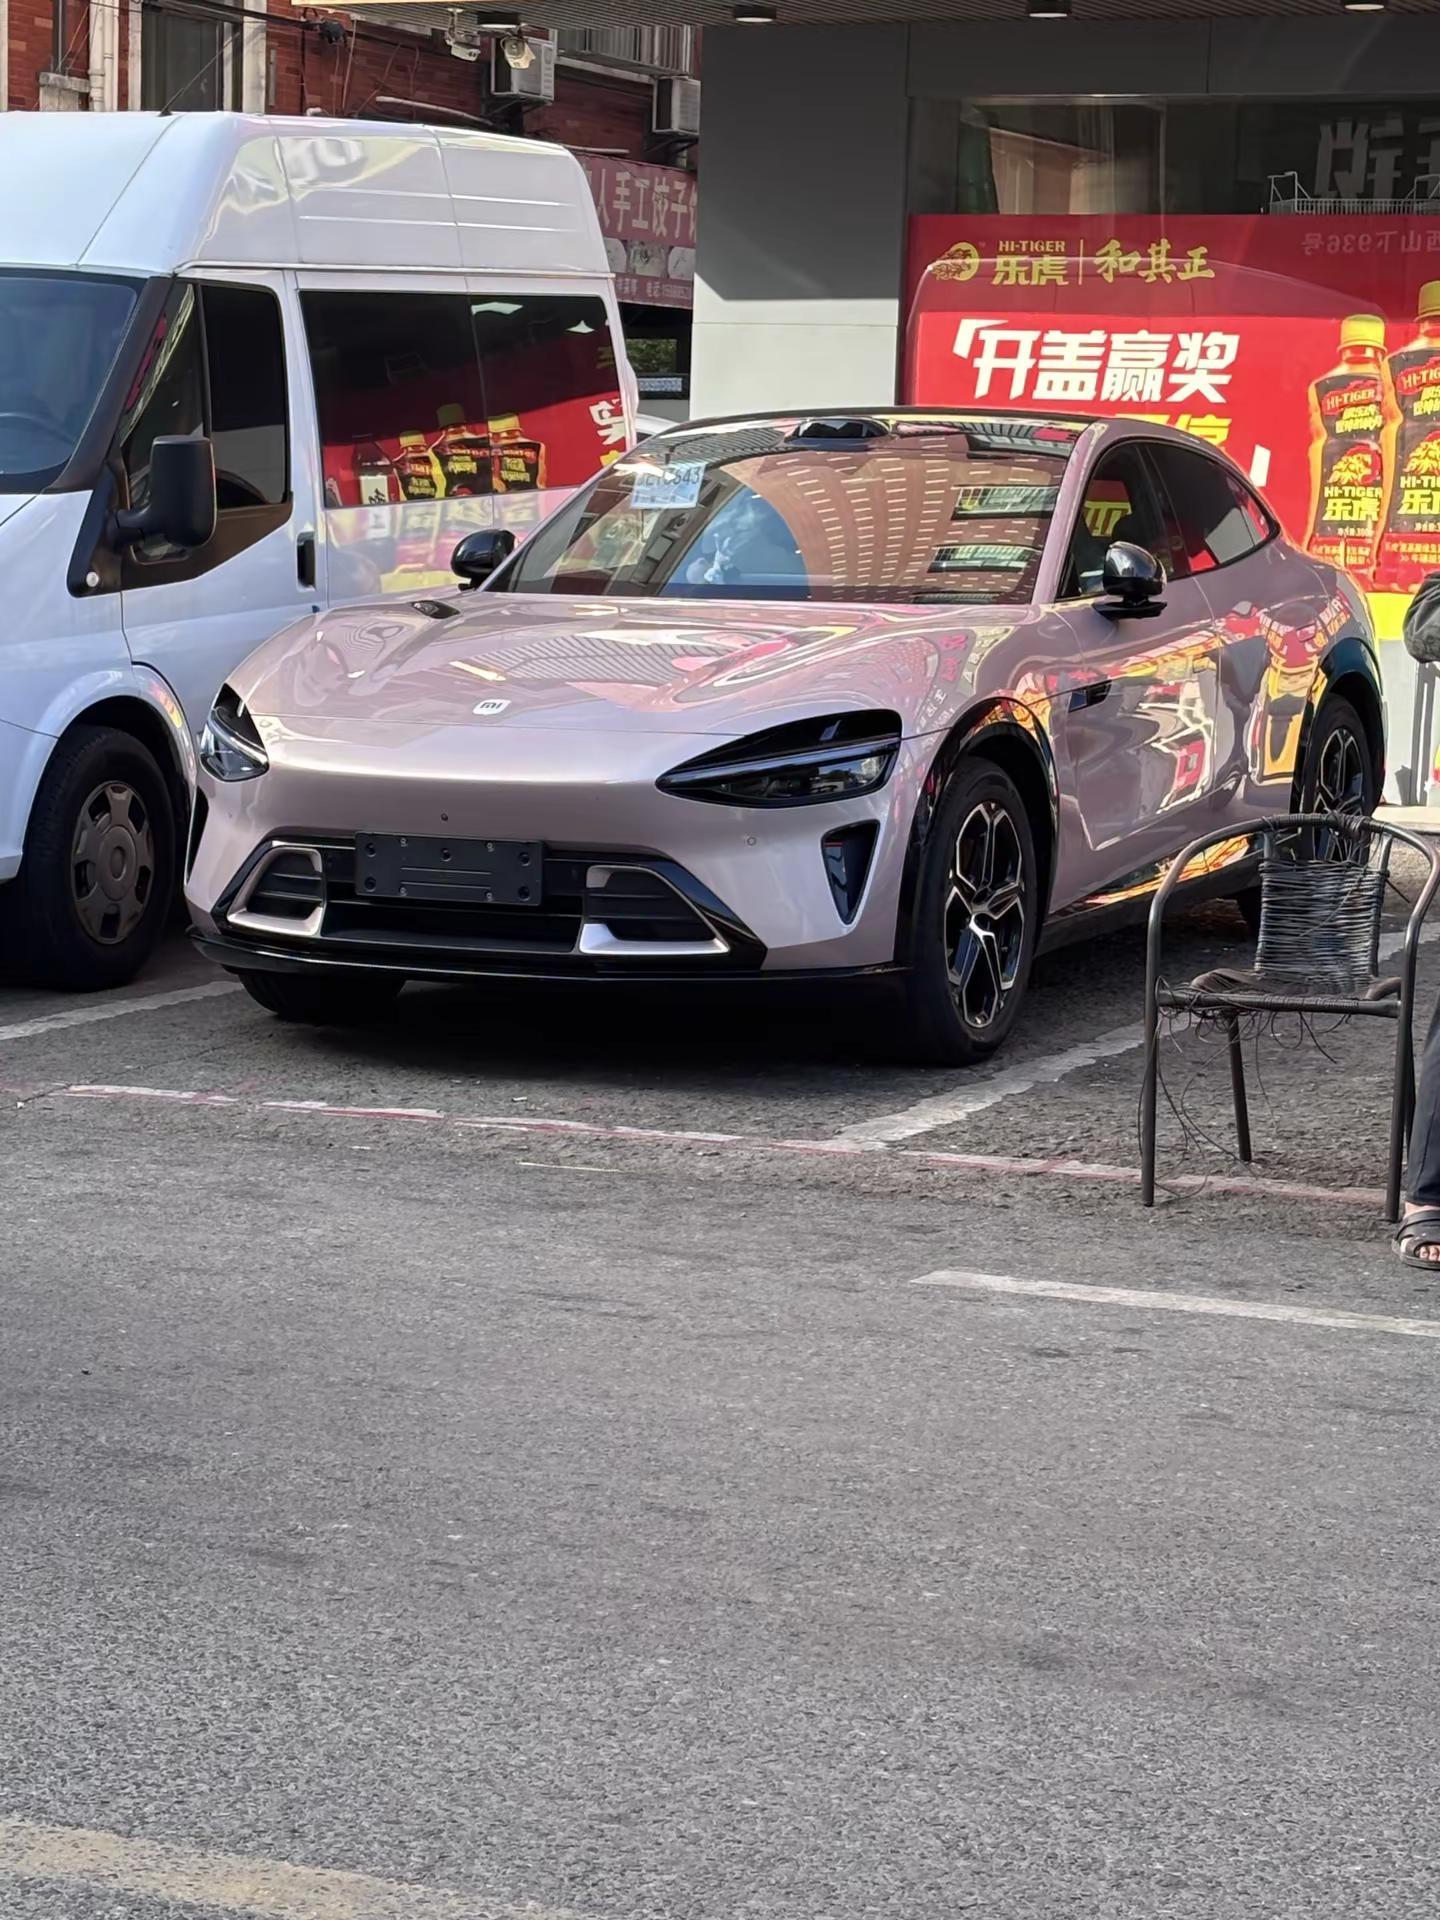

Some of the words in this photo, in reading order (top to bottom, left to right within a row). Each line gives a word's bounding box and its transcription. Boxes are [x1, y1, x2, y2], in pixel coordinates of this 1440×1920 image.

[999, 240, 1066, 253] HI-TIGER
[991, 254, 1069, 286] 乐虎
[1093, 238, 1216, 284] 和其正
[1325, 388, 1376, 410] HI-TIGER
[1322, 498, 1380, 521] 乐虎
[1397, 489, 1440, 515] 乐
